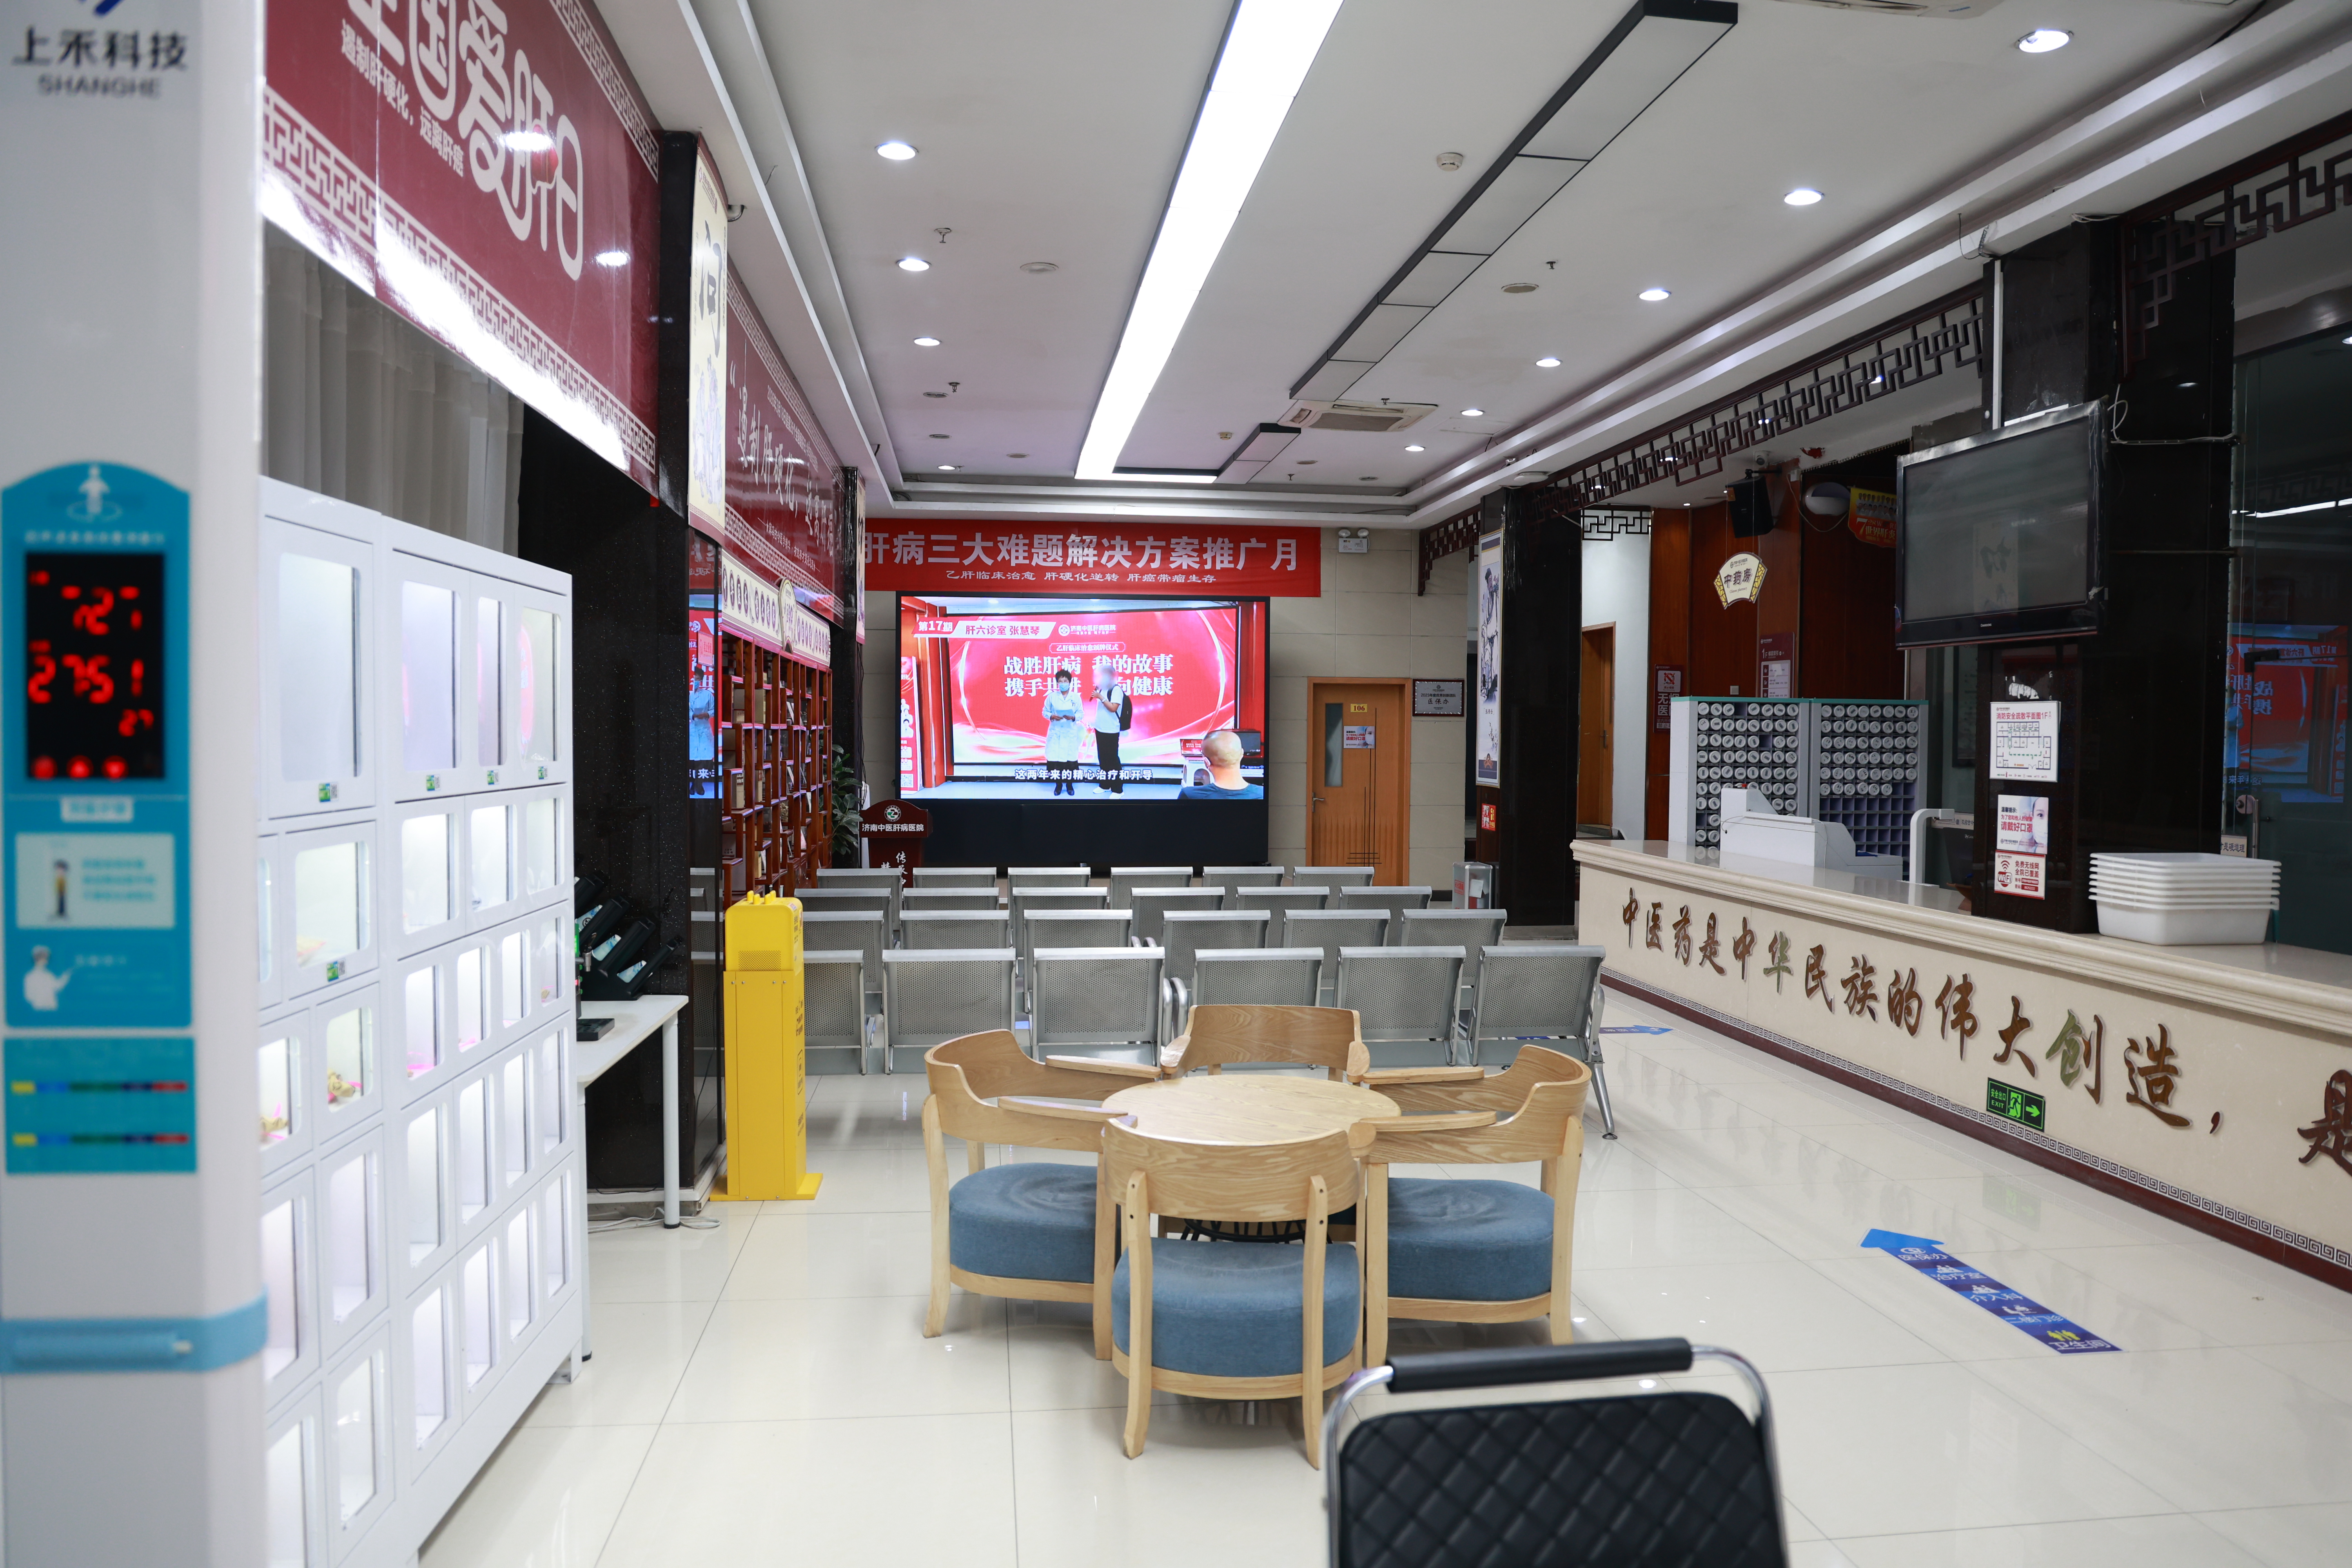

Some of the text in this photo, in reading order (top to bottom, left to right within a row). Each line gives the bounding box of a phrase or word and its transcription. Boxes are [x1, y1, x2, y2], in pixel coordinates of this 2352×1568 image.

[11, 25, 189, 71] 上禾科技
[864, 531, 1297, 571] 肝病三大难题解决方案推广月
[946, 570, 1216, 583] 乙肝临床治愈 肝硬化逆转 肝癌带瘤生存
[1724, 568, 1753, 588] 中药房
[918, 621, 1040, 635] 第17期 肝六诊室 张慧琴
[1004, 653, 1173, 675] 战胜肝病 我的故事
[1093, 676, 1173, 696] 向健康
[1014, 769, 1153, 780] 这两年来的精心治疗和开导
[862, 824, 924, 832] 济南中医肝病医院
[2001, 821, 2033, 833] 请戴好口罩
[2221, 842, 2245, 852] 是硬道理
[2015, 860, 2039, 870] 免费无线网
[2015, 868, 2039, 878] 全院已覆盖
[1998, 874, 2011, 883] WiFi
[1990, 1088, 2006, 1101] 安全出口
[1991, 1100, 2005, 1110] EXIT
[1897, 1253, 1949, 1261] 医保办
[1931, 1272, 1987, 1281] 治疗室
[1969, 1293, 2024, 1302] 介入科
[2005, 1314, 2067, 1324] 二楼门诊
[2049, 1340, 2112, 1350] 卫生间
